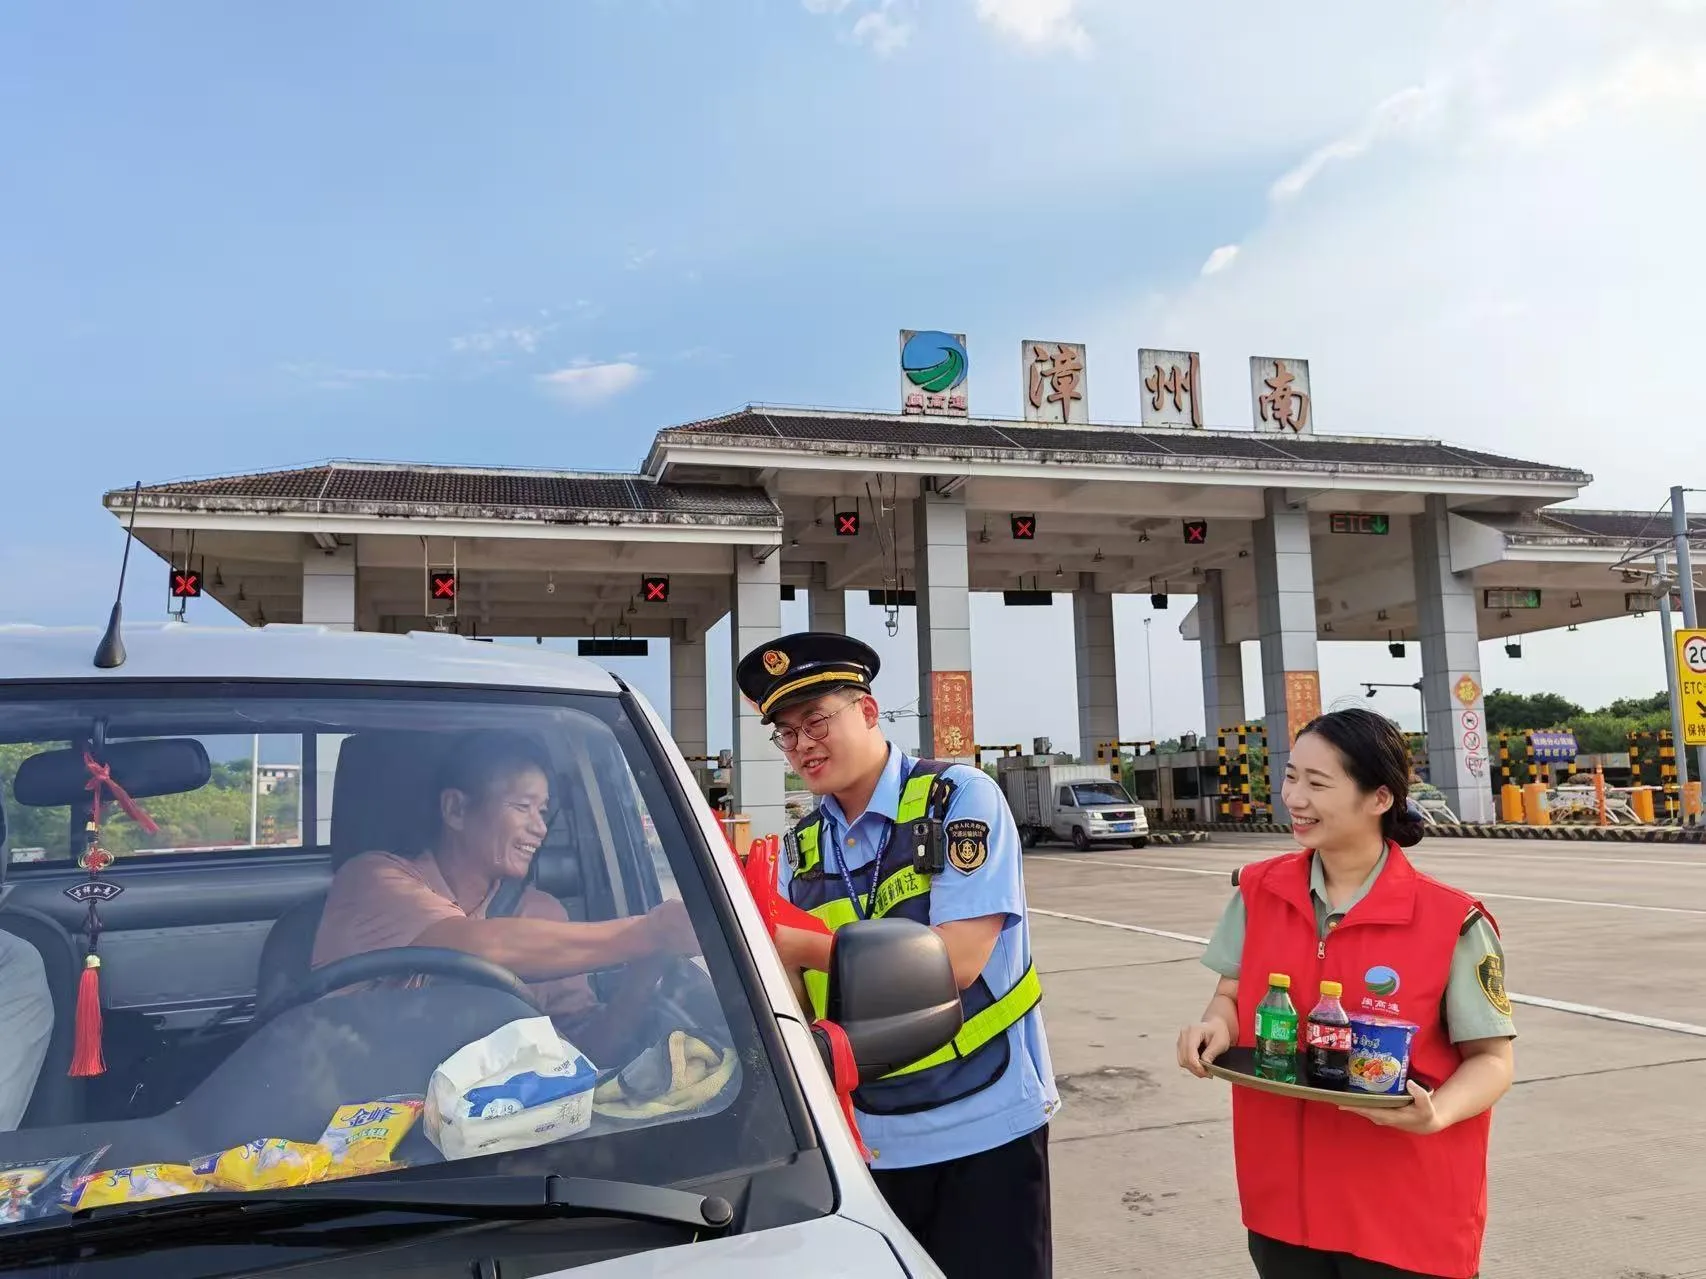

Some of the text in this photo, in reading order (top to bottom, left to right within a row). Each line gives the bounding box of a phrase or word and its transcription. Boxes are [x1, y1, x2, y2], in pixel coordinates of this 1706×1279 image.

[1028, 344, 1310, 432] 漳州南
[1333, 514, 1372, 533] ETC
[1684, 681, 1706, 694] ETC
